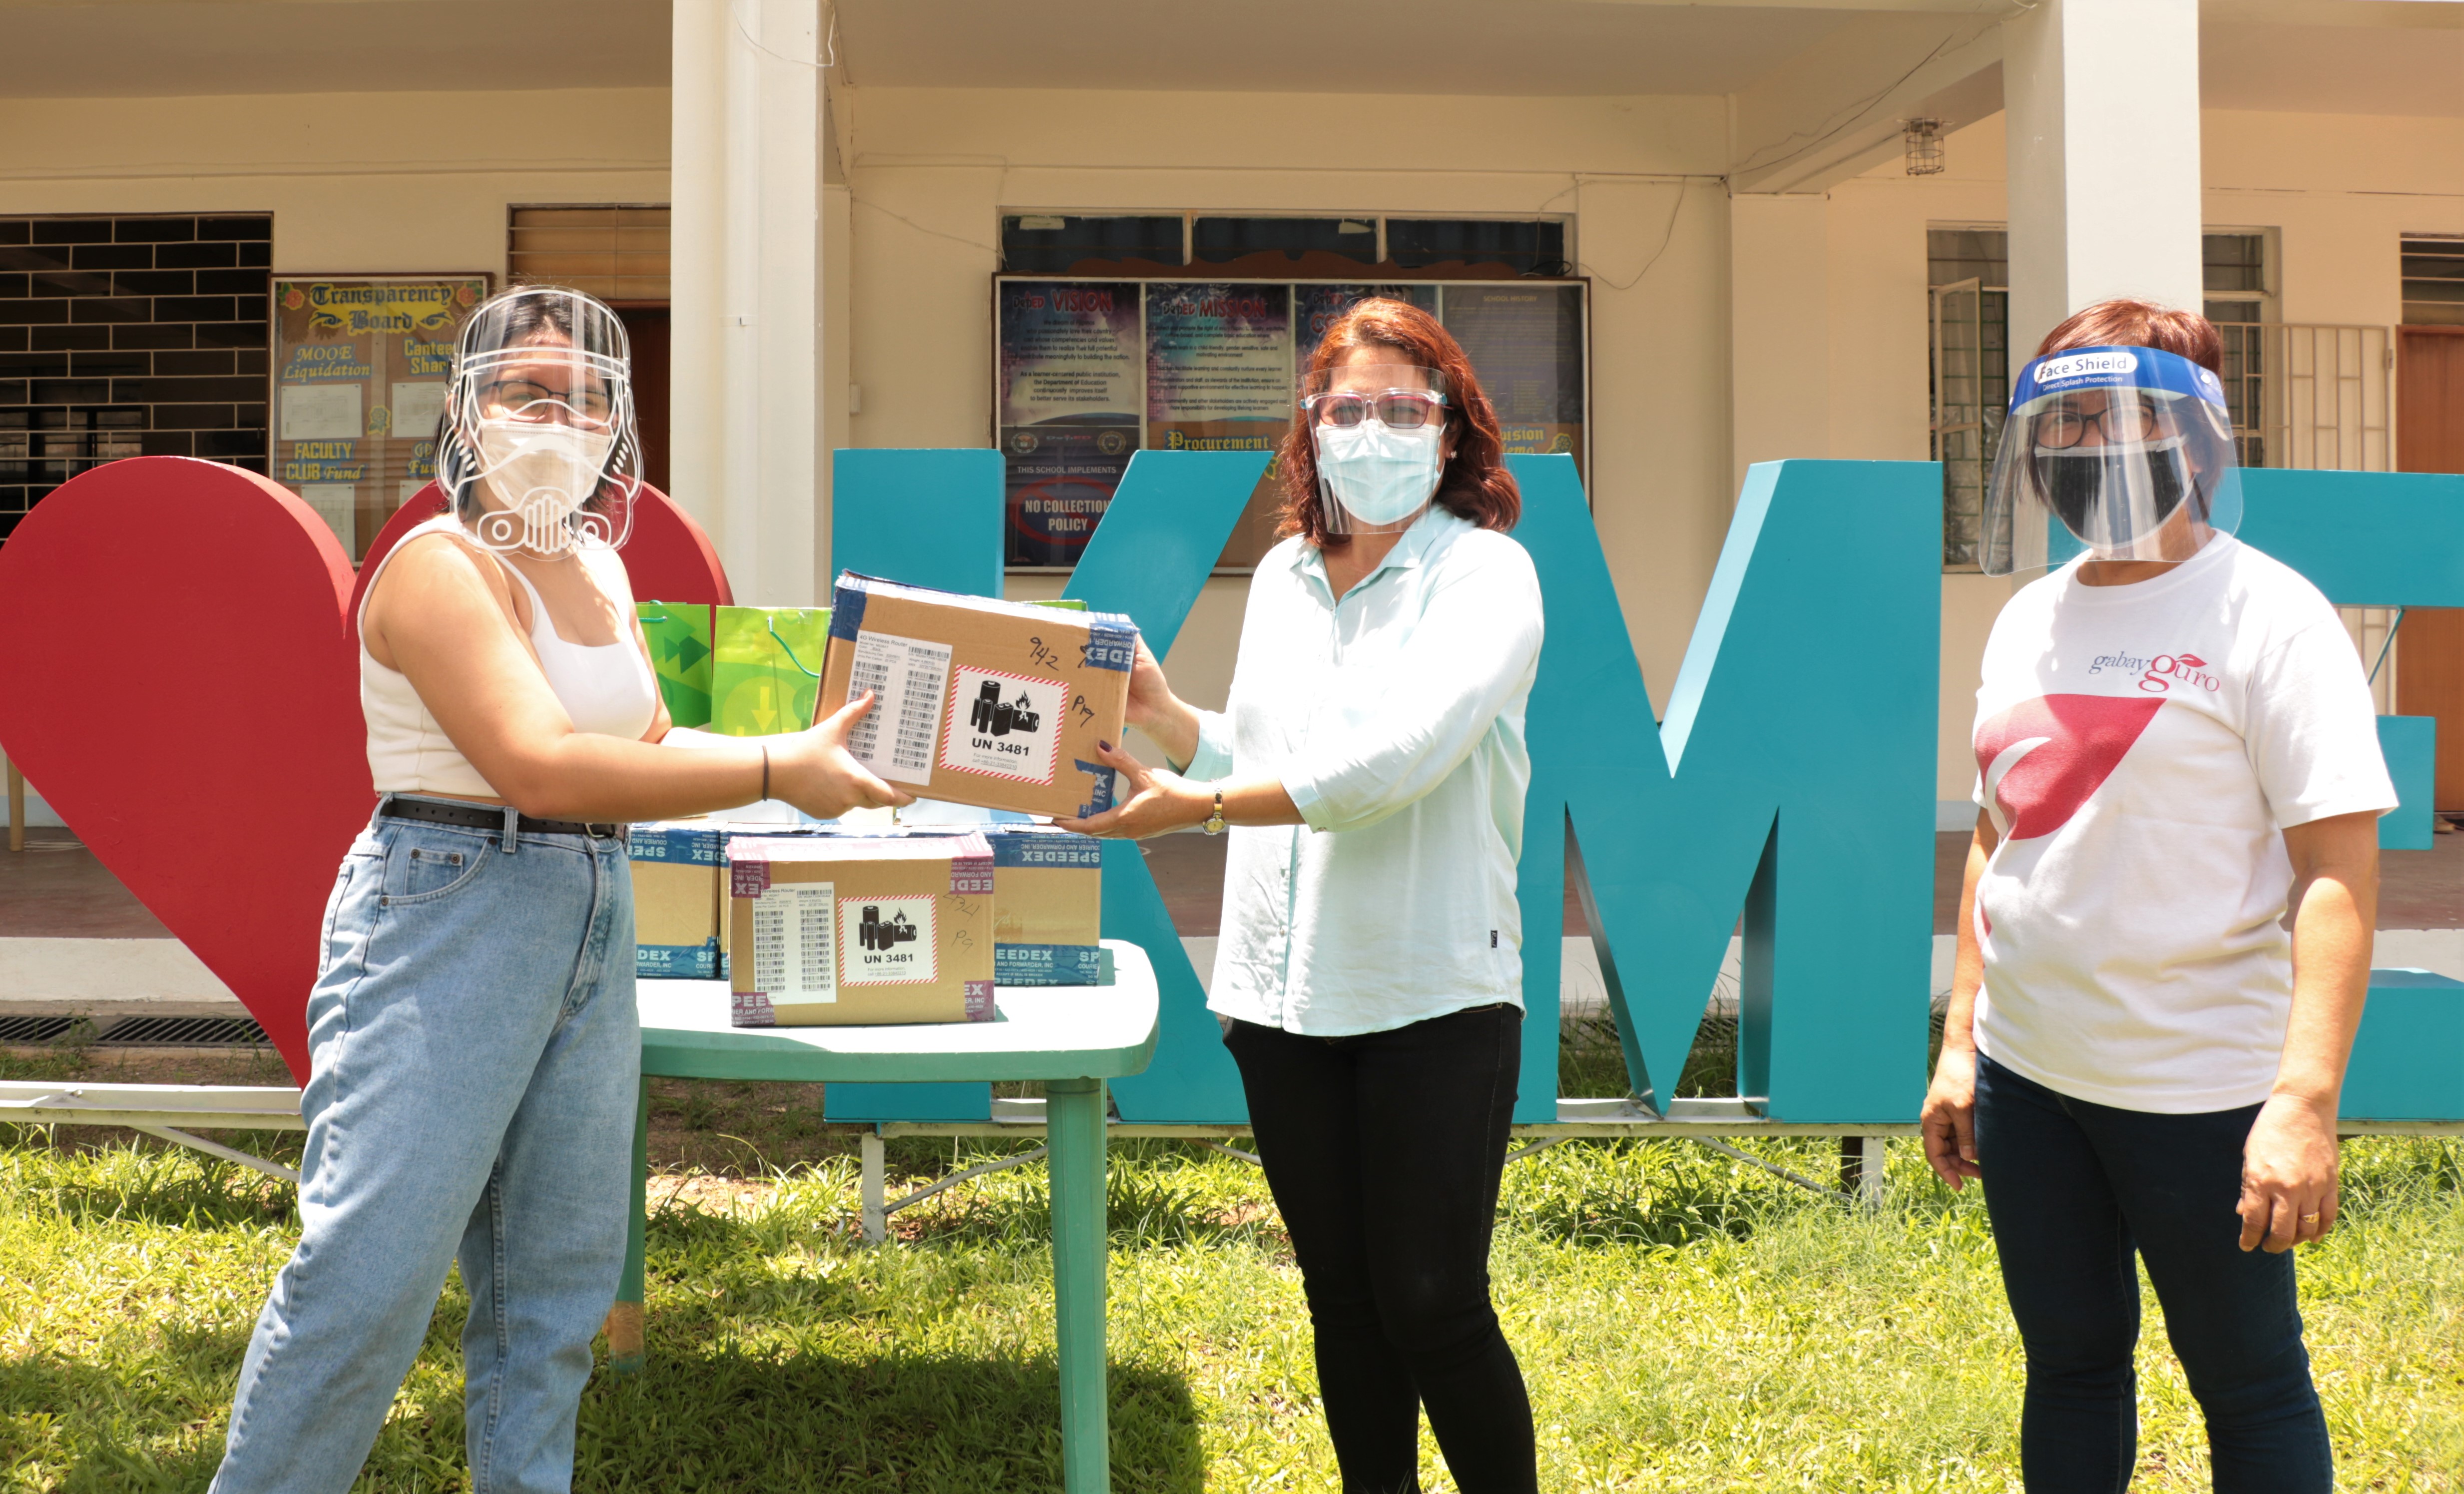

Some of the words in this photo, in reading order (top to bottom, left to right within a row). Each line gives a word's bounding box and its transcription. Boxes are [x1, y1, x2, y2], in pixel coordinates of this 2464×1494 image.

[311, 285, 452, 307] Transparency
[1052, 291, 1112, 312] VISION
[1199, 299, 1266, 317] MISSION
[350, 310, 413, 330] Board
[297, 346, 353, 362] MOOE
[2075, 356, 2127, 372] Shield
[284, 362, 370, 383] Liquidation
[2043, 382, 2060, 391] Direct
[1167, 432, 1269, 450] Procurement
[295, 443, 352, 459] FACULTY
[286, 464, 320, 480] CLUB
[324, 465, 364, 480] Fund
[1025, 500, 1040, 512] NO
[1043, 500, 1110, 512] COLLECTION
[1048, 518, 1088, 531] POLICY
[1030, 637, 1059, 671] 942
[972, 737, 992, 750] UN
[997, 742, 1029, 756] 3481
[1094, 789, 1106, 797] INC
[1022, 851, 1100, 863] SPEEDEX
[735, 883, 759, 895] EX
[637, 950, 671, 961] DEX
[864, 955, 881, 964] UN
[886, 953, 913, 963] 3481
[996, 949, 1052, 961] EEDEX
[1079, 951, 1099, 962] SP
[964, 984, 984, 996] EX
[731, 996, 766, 1007] PEE
